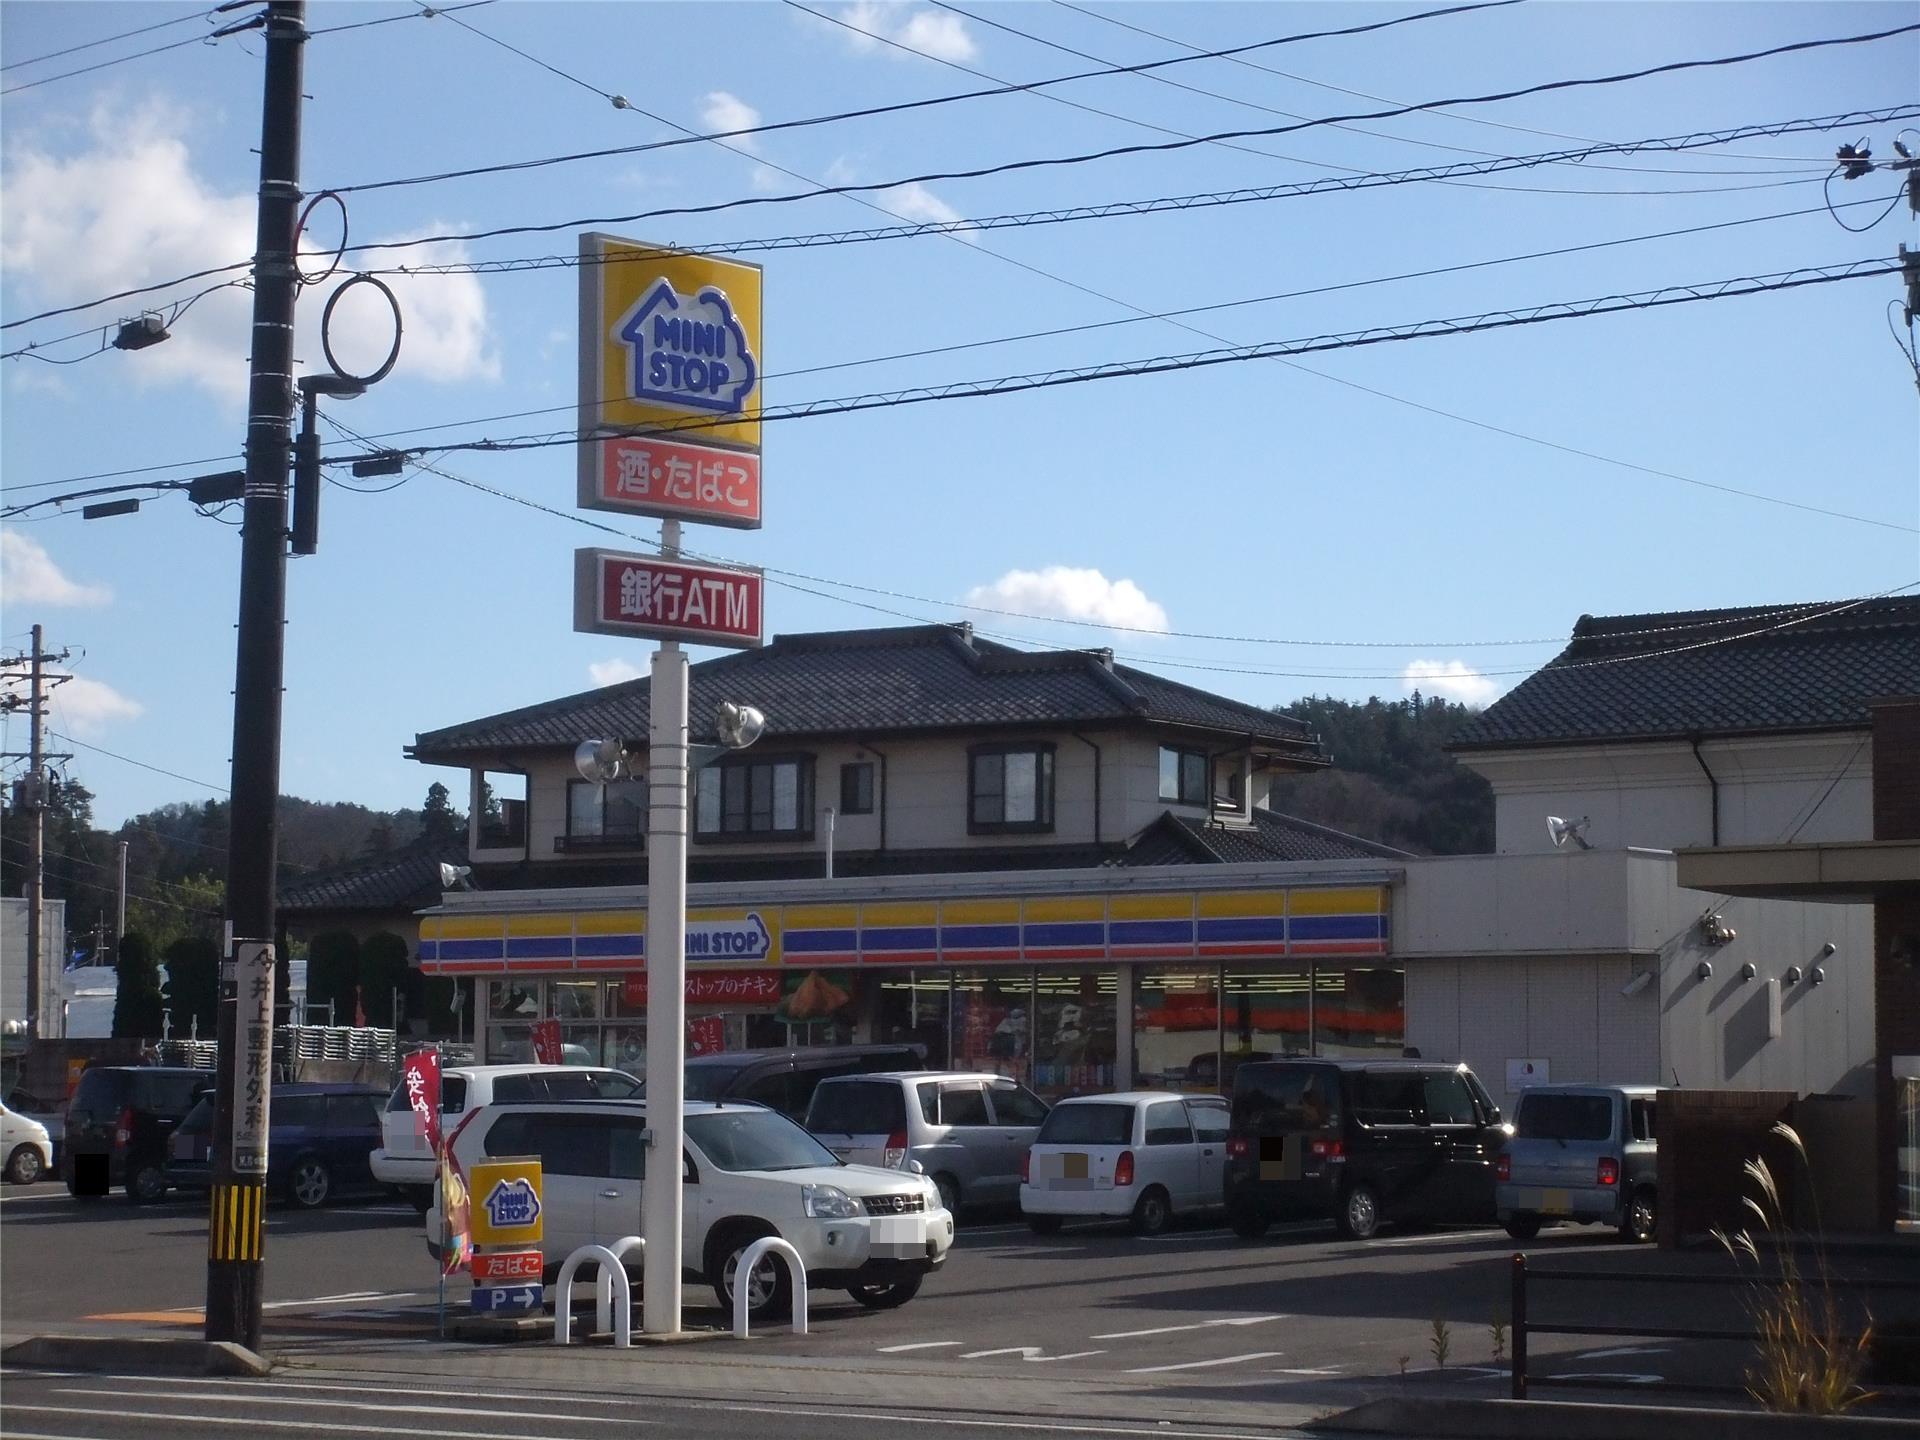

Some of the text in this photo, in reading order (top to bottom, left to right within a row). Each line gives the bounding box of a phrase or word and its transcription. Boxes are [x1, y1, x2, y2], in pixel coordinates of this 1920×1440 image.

[654, 314, 726, 359] MINI
[650, 351, 730, 395] STOP
[617, 448, 749, 507] 酒・たばこ
[621, 567, 748, 630] 銀行ATM
[685, 931, 759, 954] INI STOP
[499, 1191, 529, 1208] MINI
[498, 1205, 531, 1221] STOP
[487, 1257, 540, 1275] たばこ
[491, 1289, 507, 1310] P
